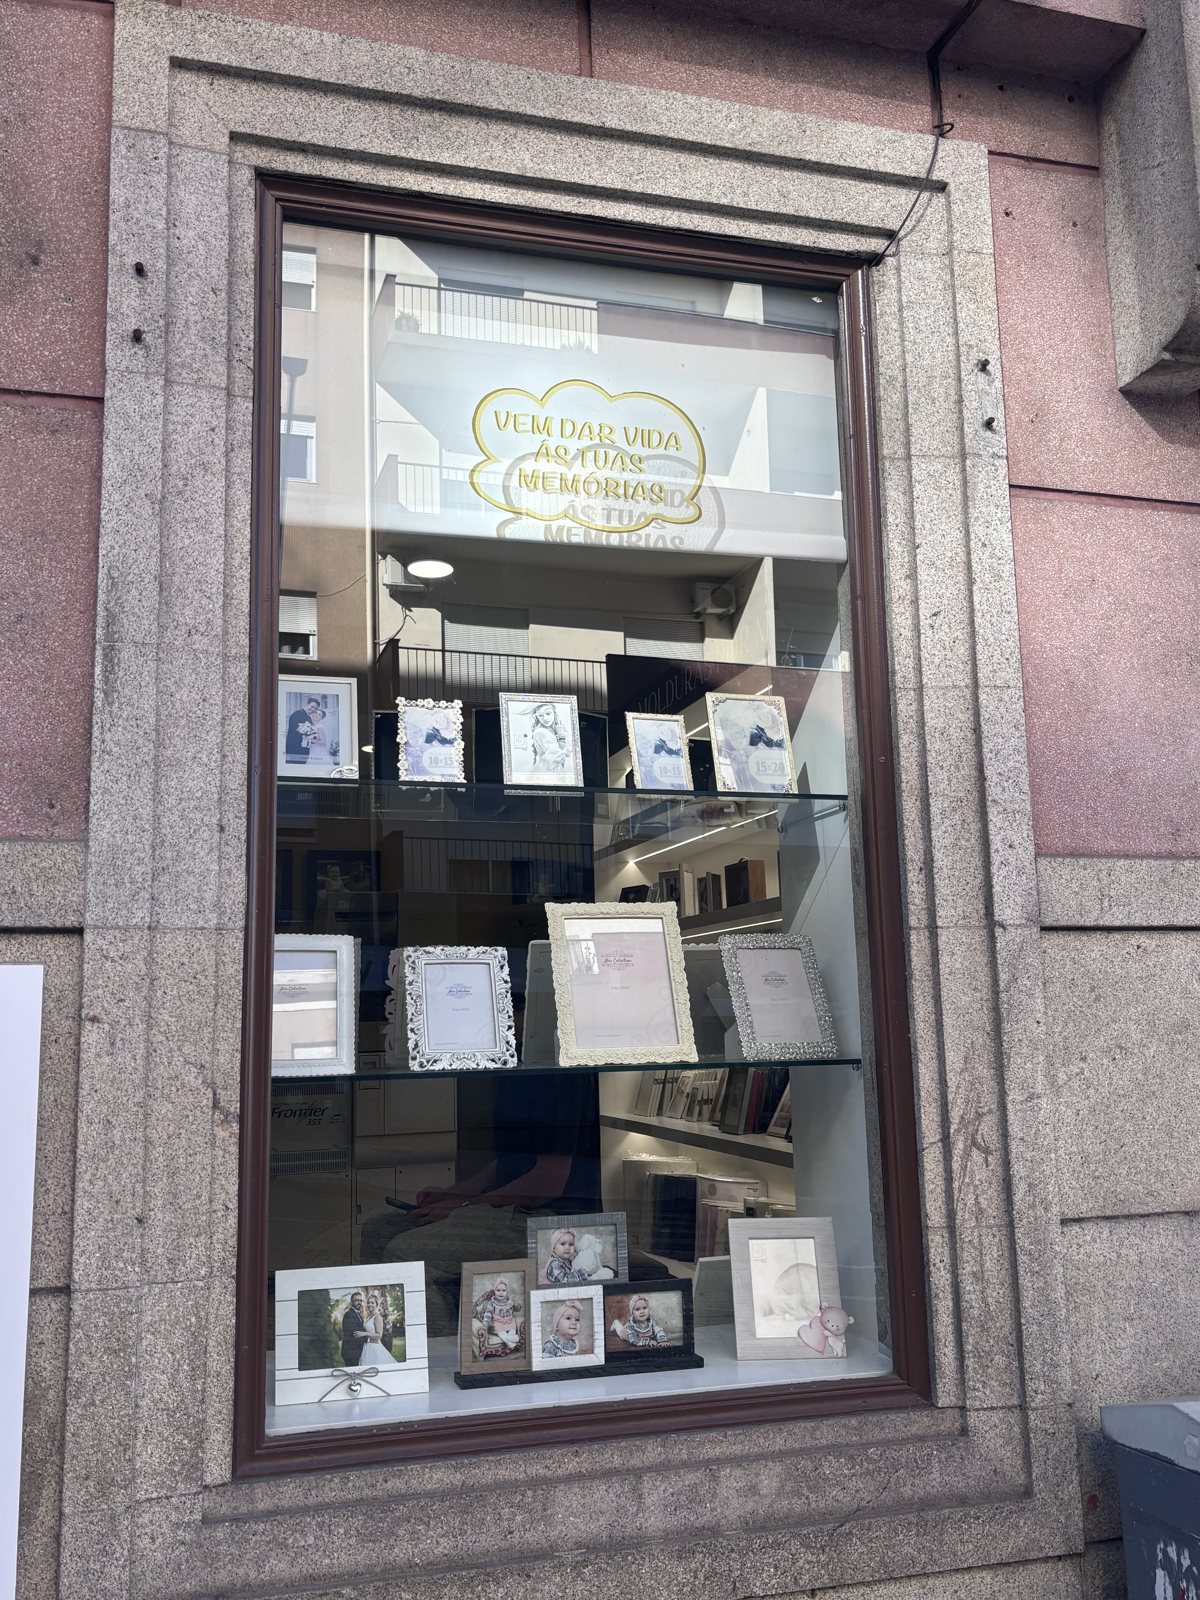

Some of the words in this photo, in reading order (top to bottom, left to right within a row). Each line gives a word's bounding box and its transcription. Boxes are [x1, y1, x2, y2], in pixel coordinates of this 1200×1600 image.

[494, 410, 554, 437] VEM
[560, 418, 617, 445] DAR
[624, 426, 683, 451] VIDA
[576, 448, 646, 474] TUAS
[518, 467, 666, 504] MEMÓRIAS
[271, 1105, 328, 1120] Frontier
